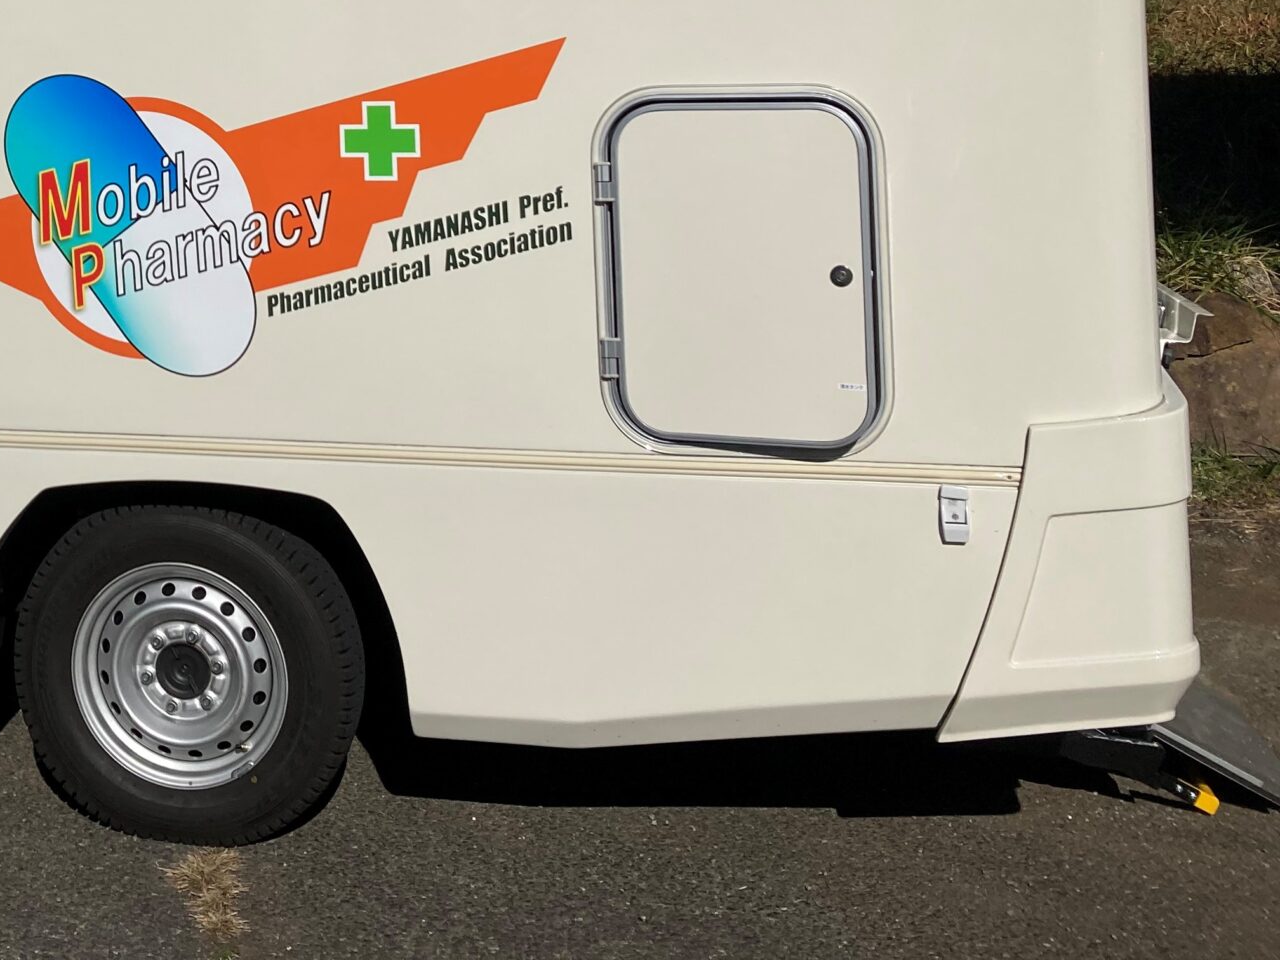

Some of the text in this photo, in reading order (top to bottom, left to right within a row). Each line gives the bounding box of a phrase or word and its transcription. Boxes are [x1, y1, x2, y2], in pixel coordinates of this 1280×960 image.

[37, 150, 220, 246] Mobile
[387, 185, 569, 253] YAMANASHI Pref.
[71, 190, 331, 311] Pharmacy
[266, 221, 573, 318] Pharmaceutical Association
